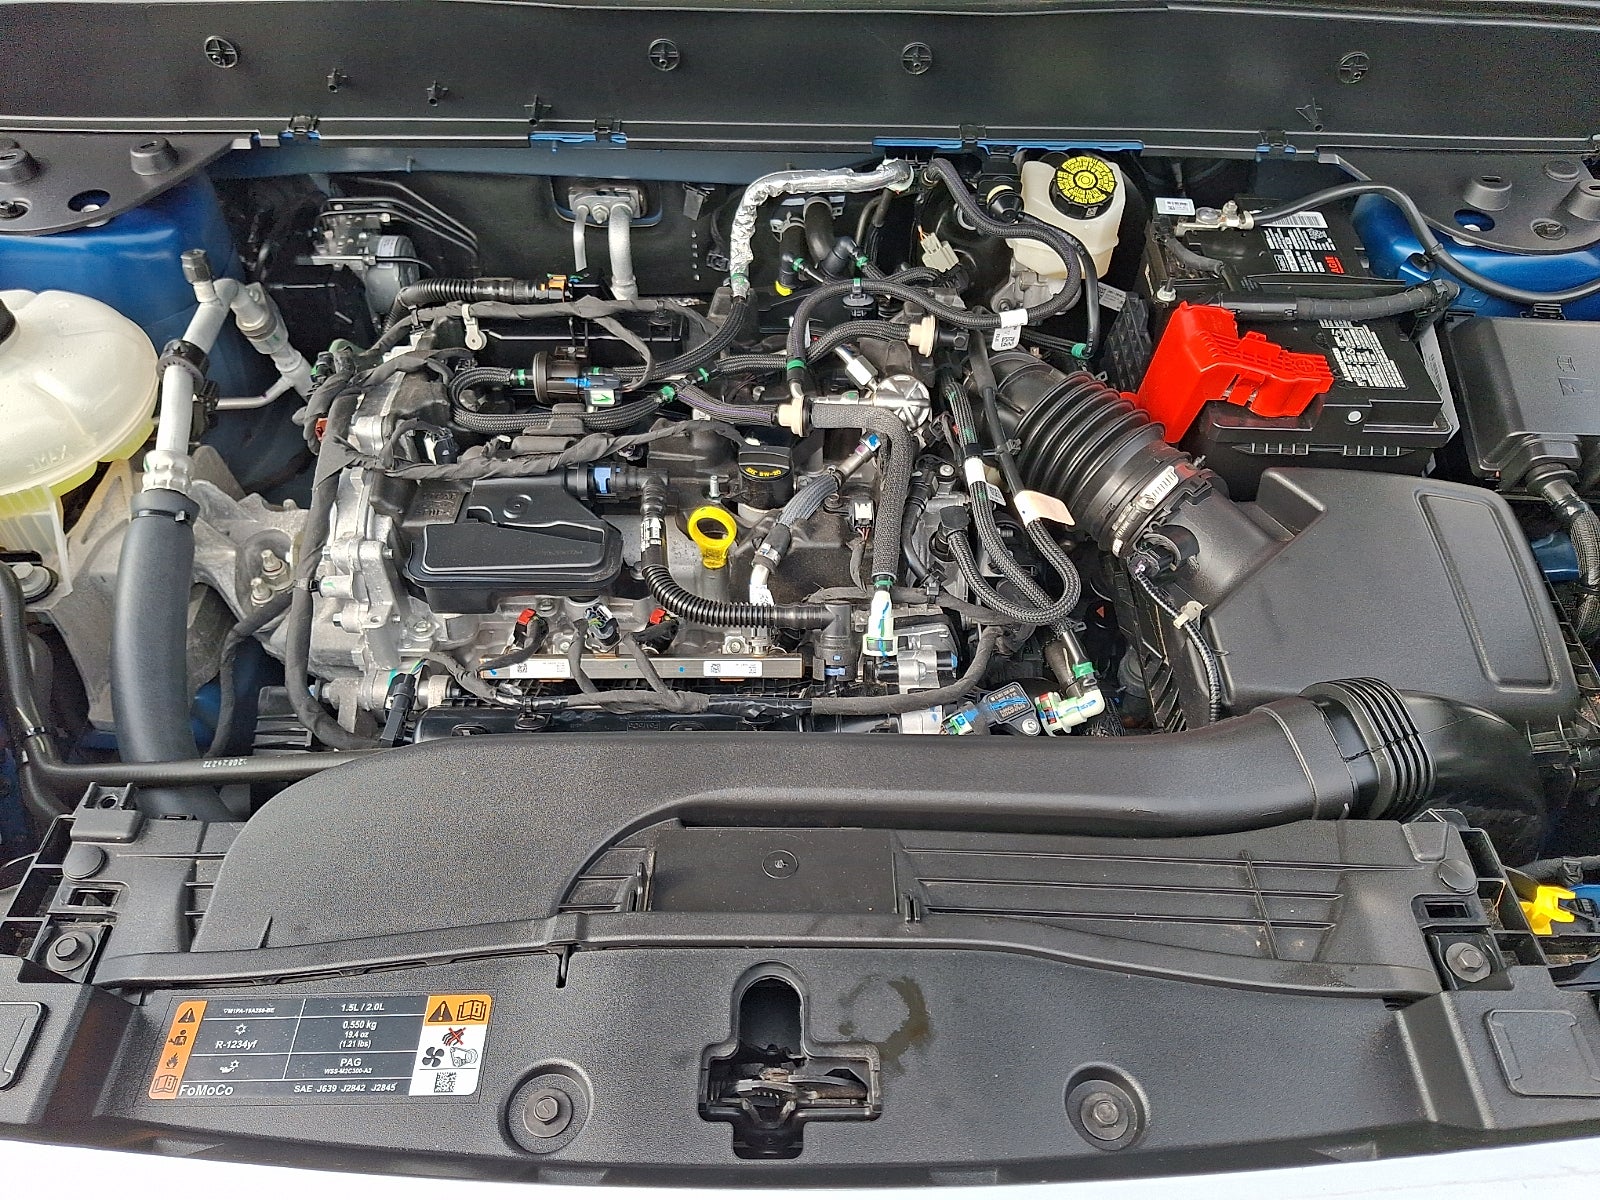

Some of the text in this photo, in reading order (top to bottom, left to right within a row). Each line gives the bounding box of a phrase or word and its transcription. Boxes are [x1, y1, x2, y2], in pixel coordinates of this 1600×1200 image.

[341, 1003, 359, 1012] 1.5L
[366, 1003, 385, 1011] 2.0L
[342, 1020, 377, 1031] 0.550 kg
[344, 1030, 359, 1038] 19.4
[214, 1040, 259, 1051] R-1234yf
[339, 1039, 372, 1049] (1.21 lbs)
[340, 1058, 362, 1067] PAG
[178, 1083, 234, 1096] FoMoCo
[293, 1083, 397, 1093] SAE J639 J2842 J2845
